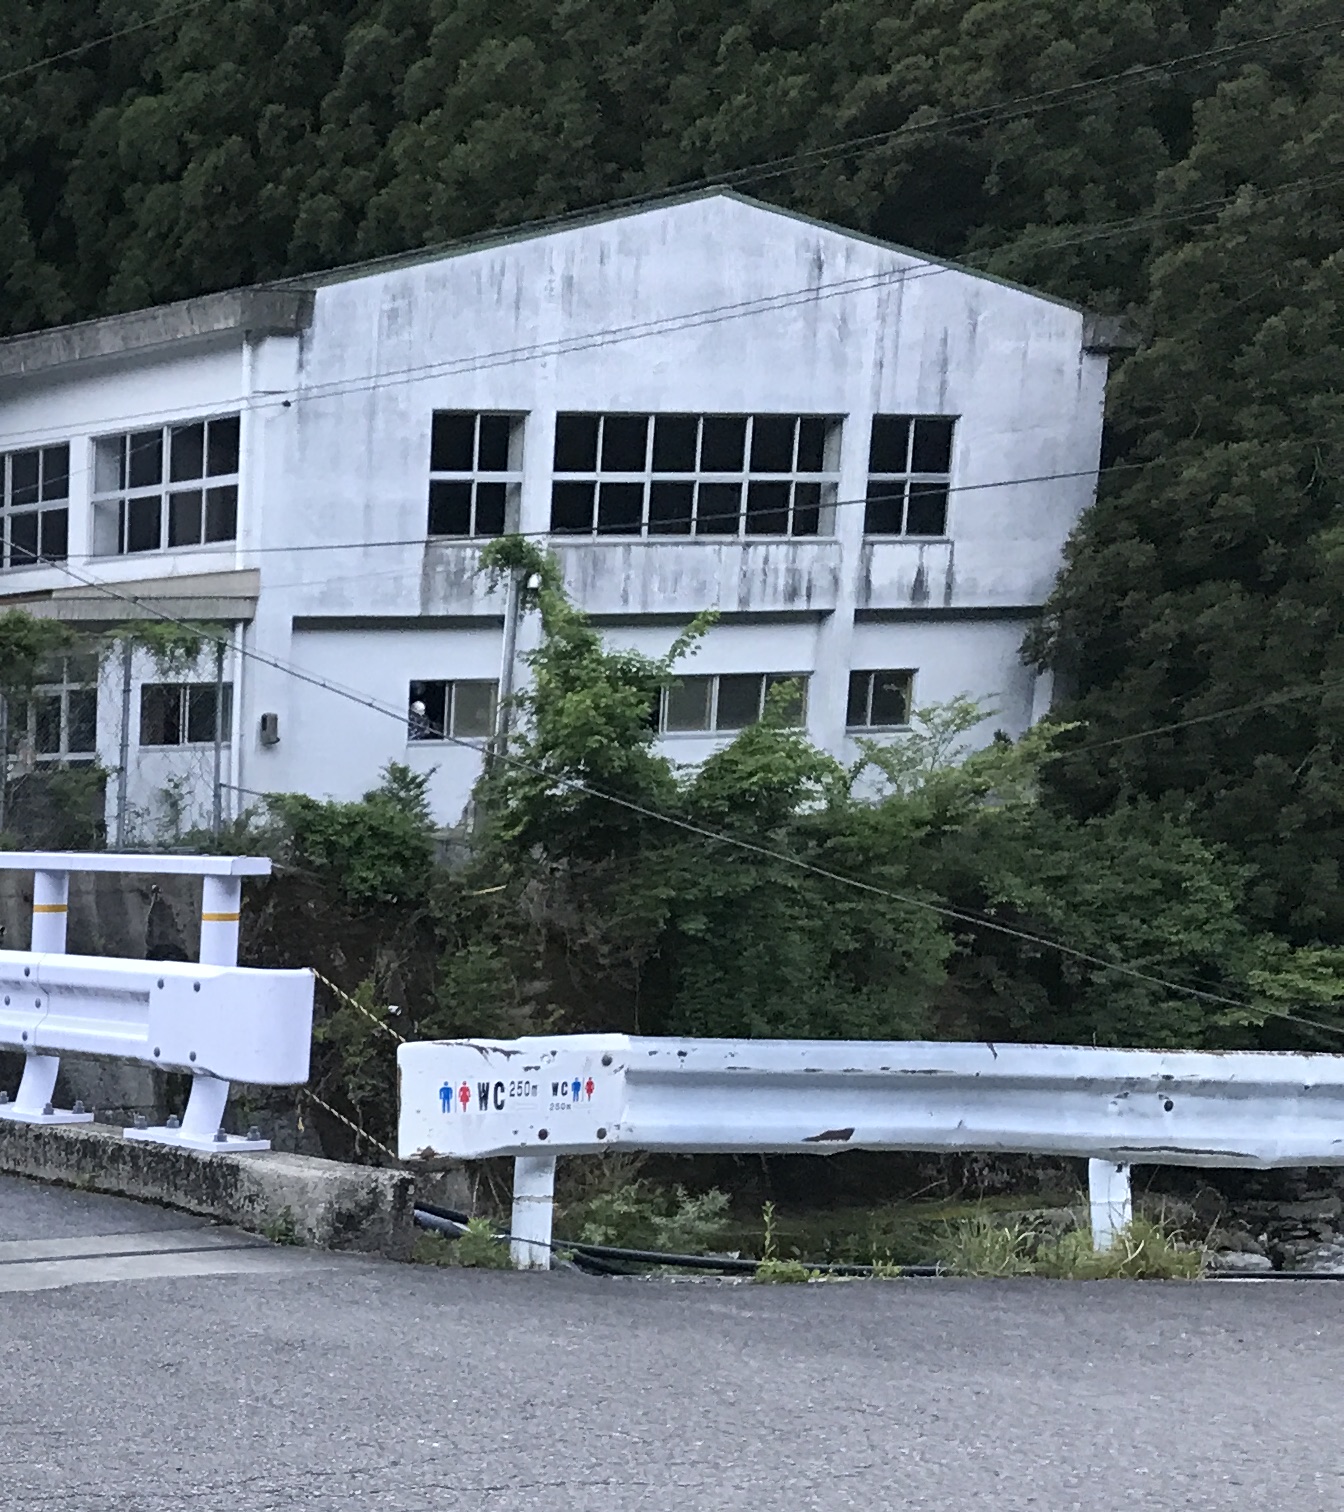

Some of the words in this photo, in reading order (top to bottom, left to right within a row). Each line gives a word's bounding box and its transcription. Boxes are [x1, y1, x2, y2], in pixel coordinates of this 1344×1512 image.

[477, 1081, 506, 1111] WC
[508, 1080, 539, 1098] 250m
[551, 1081, 569, 1097] WC
